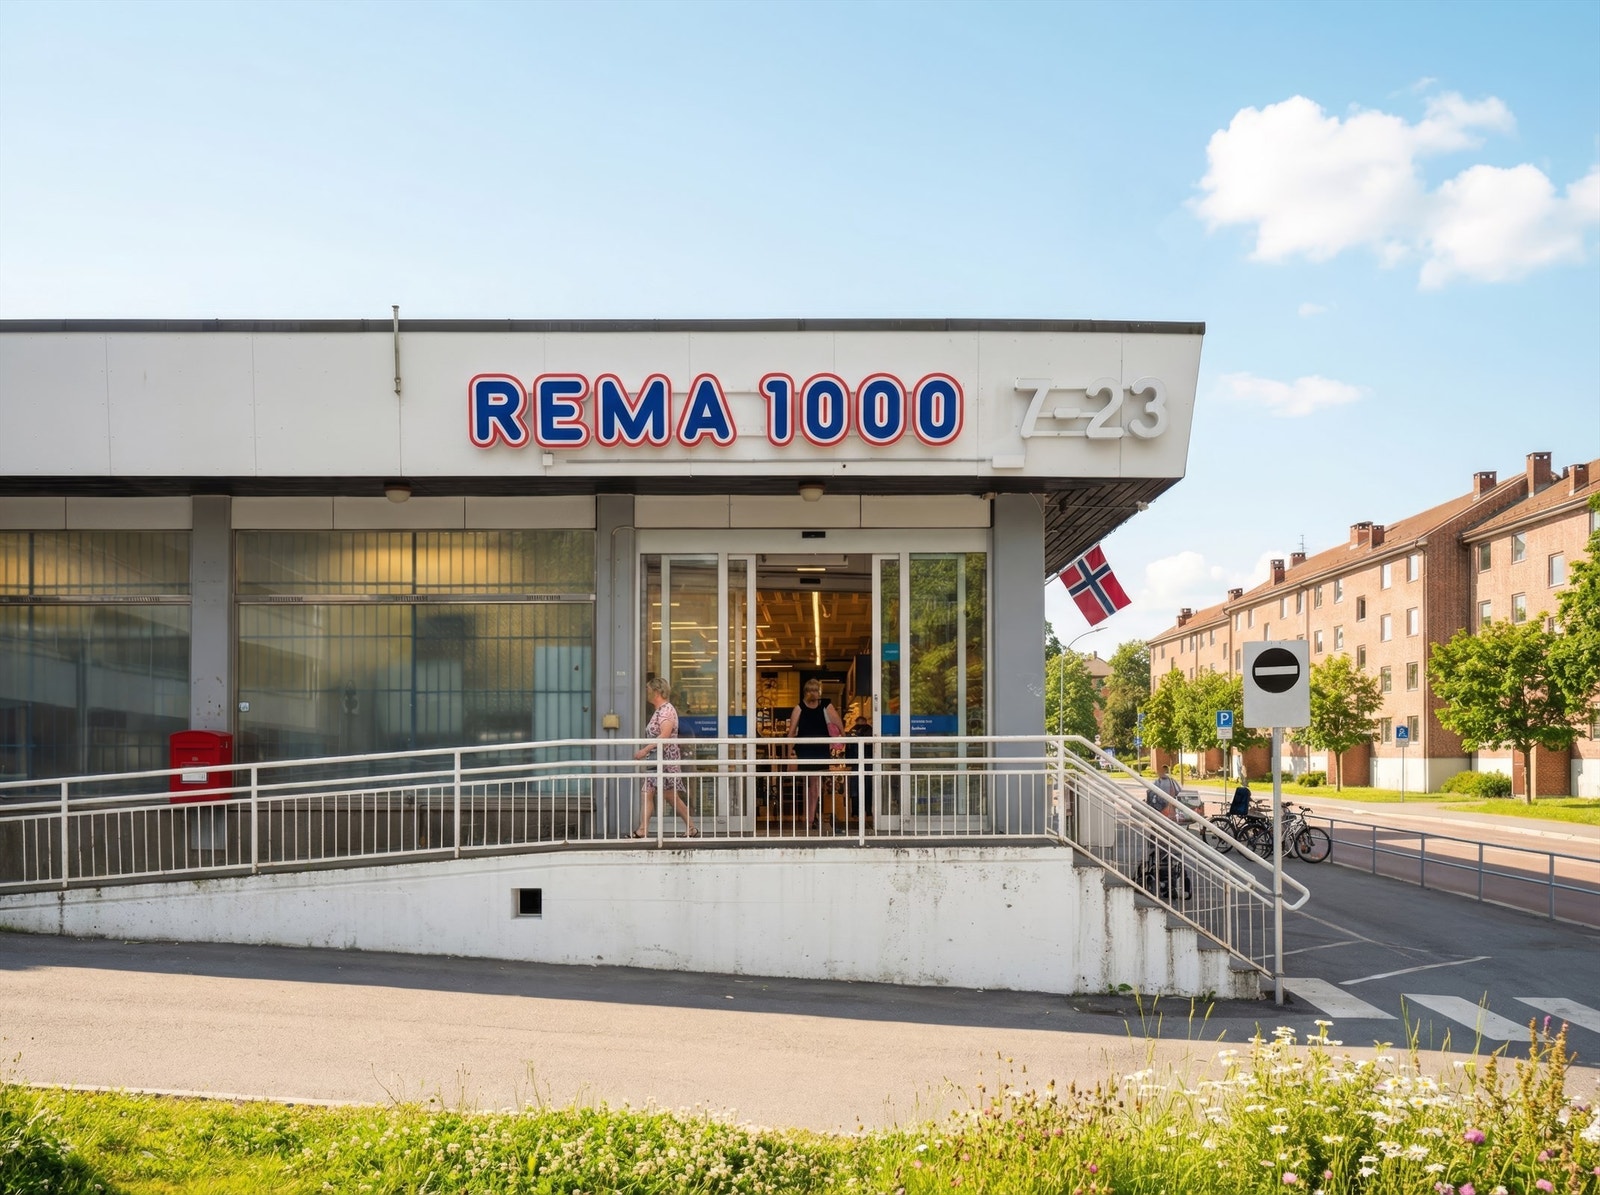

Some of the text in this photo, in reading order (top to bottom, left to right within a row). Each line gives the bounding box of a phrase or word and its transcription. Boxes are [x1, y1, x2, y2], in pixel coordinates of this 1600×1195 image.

[468, 372, 965, 449] REMA 1000
[1014, 376, 1170, 440] 7-23
[1220, 712, 1230, 725] P
